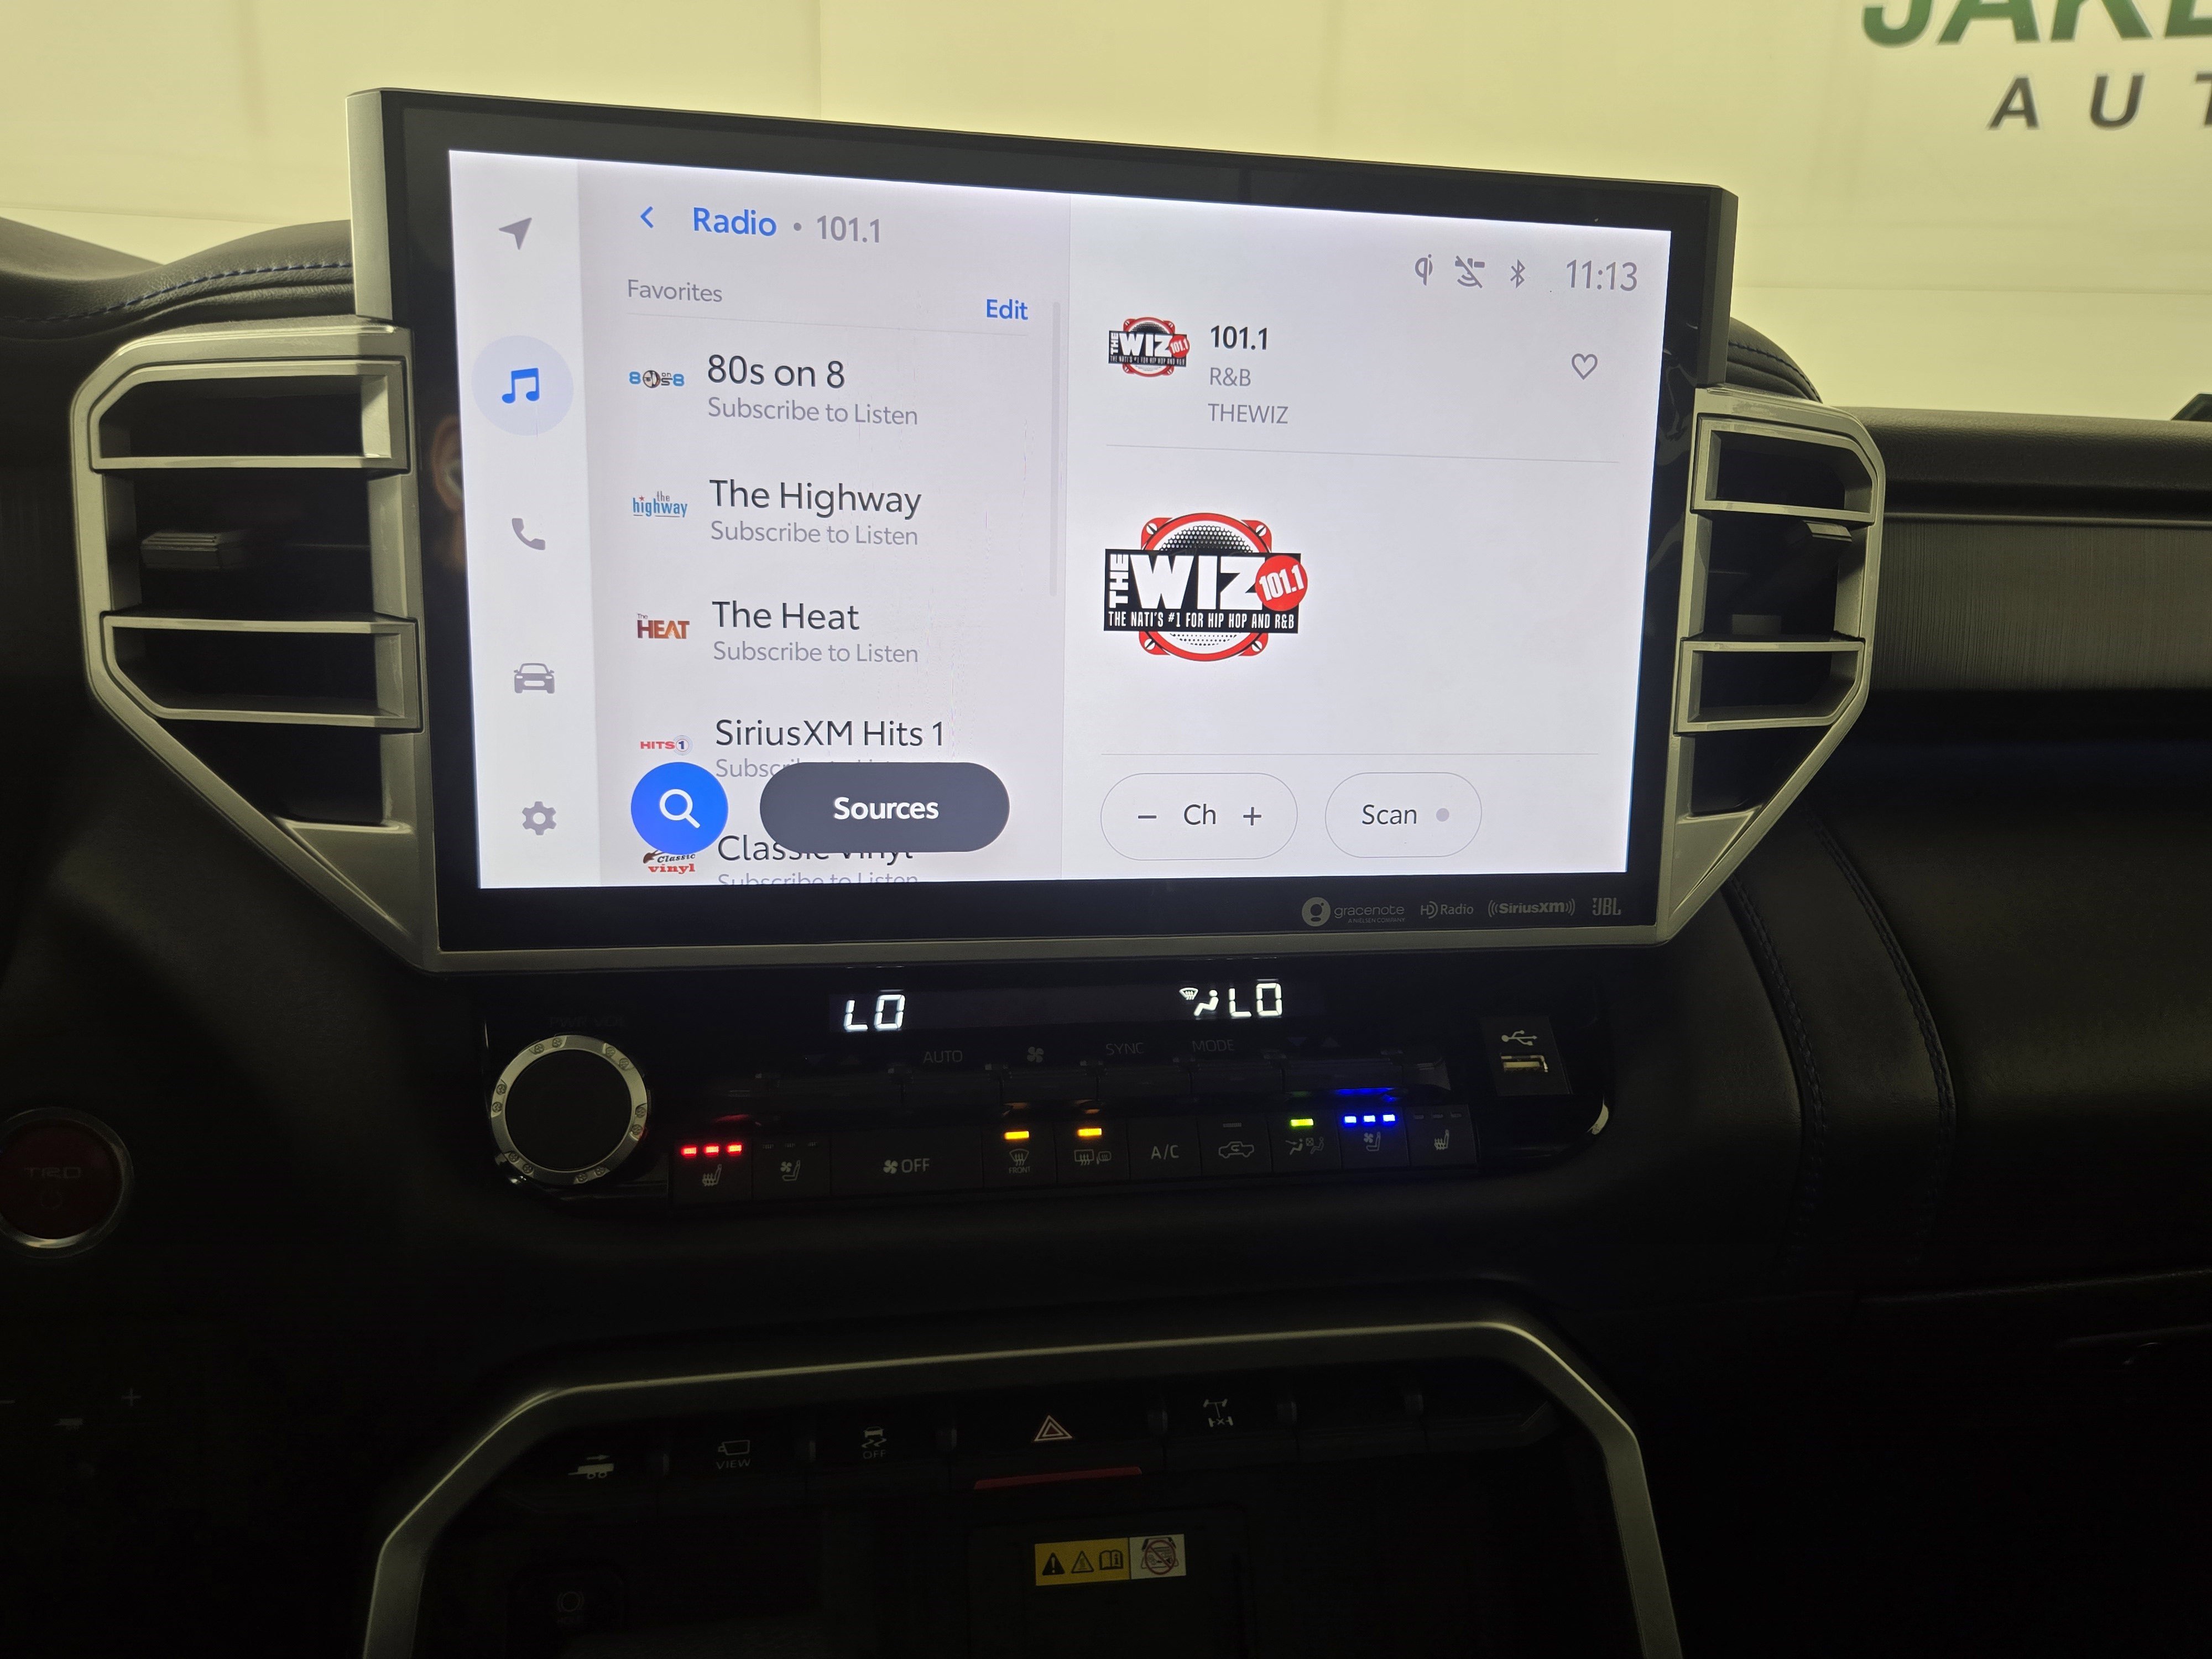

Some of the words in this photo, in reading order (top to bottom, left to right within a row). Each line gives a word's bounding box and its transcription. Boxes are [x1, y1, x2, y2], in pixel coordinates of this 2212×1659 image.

[693, 207, 776, 237] Radio
[817, 215, 881, 244] 101.1
[1567, 259, 1638, 291] 11:13
[627, 279, 723, 304] Favorites
[986, 299, 1029, 321] Edit
[1110, 332, 1119, 355] THE
[1119, 333, 1173, 357] WIZ
[1170, 338, 1188, 354] 101.1
[1210, 325, 1269, 351] 101.1
[708, 354, 765, 385] 80s
[775, 363, 816, 387] on
[826, 359, 846, 389] 8
[1209, 367, 1252, 387] R&B
[708, 397, 820, 422] Subscribe
[826, 401, 848, 422] to
[854, 405, 918, 425] Listen
[1208, 403, 1289, 425] THEWIZ
[656, 491, 670, 502] the
[710, 480, 770, 508] The
[780, 481, 922, 520] Highway
[633, 498, 688, 518] highway
[711, 521, 820, 544] Subscribe
[827, 526, 848, 544] to
[855, 526, 918, 545] Listen
[1109, 554, 1129, 608] THE
[1130, 554, 1265, 611] WIZ
[1259, 565, 1305, 602] 101.1
[712, 602, 771, 629] The
[782, 603, 860, 630] Heat
[1108, 612, 1126, 627] THE
[1131, 612, 1164, 627] NATI'S
[1168, 612, 1181, 628] #1
[1186, 612, 1203, 628] FOR
[1208, 613, 1224, 628] HIP
[1229, 613, 1247, 629] HOP
[1251, 613, 1270, 629] AND
[1275, 614, 1295, 629] R&B
[637, 620, 690, 639] HEAT
[713, 641, 822, 661] Subscribe
[828, 645, 850, 661] to
[857, 644, 919, 662] Listen
[716, 719, 853, 747] SiriusXM
[864, 721, 924, 747] Hits
[933, 722, 943, 746] 1
[640, 741, 675, 750] HITS
[679, 741, 685, 750] 1
[833, 797, 939, 820] Sources
[1183, 803, 1216, 827] Ch
[1361, 803, 1417, 826] Scan
[648, 864, 695, 874] vinyl
[1334, 904, 1405, 919] gracenote
[1441, 904, 1474, 915] Radio
[1593, 897, 1621, 916] JBL
[1105, 1042, 1144, 1055] SYNC
[1192, 1039, 1234, 1052] MODE
[923, 1050, 963, 1063] AUTO
[1151, 1144, 1179, 1160] A/C
[24, 1166, 82, 1179] TRD
[901, 1159, 930, 1173] OFF
[1009, 1166, 1030, 1174] FRONT
[716, 1458, 751, 1470] VIEW
[862, 1449, 886, 1460] OFF
